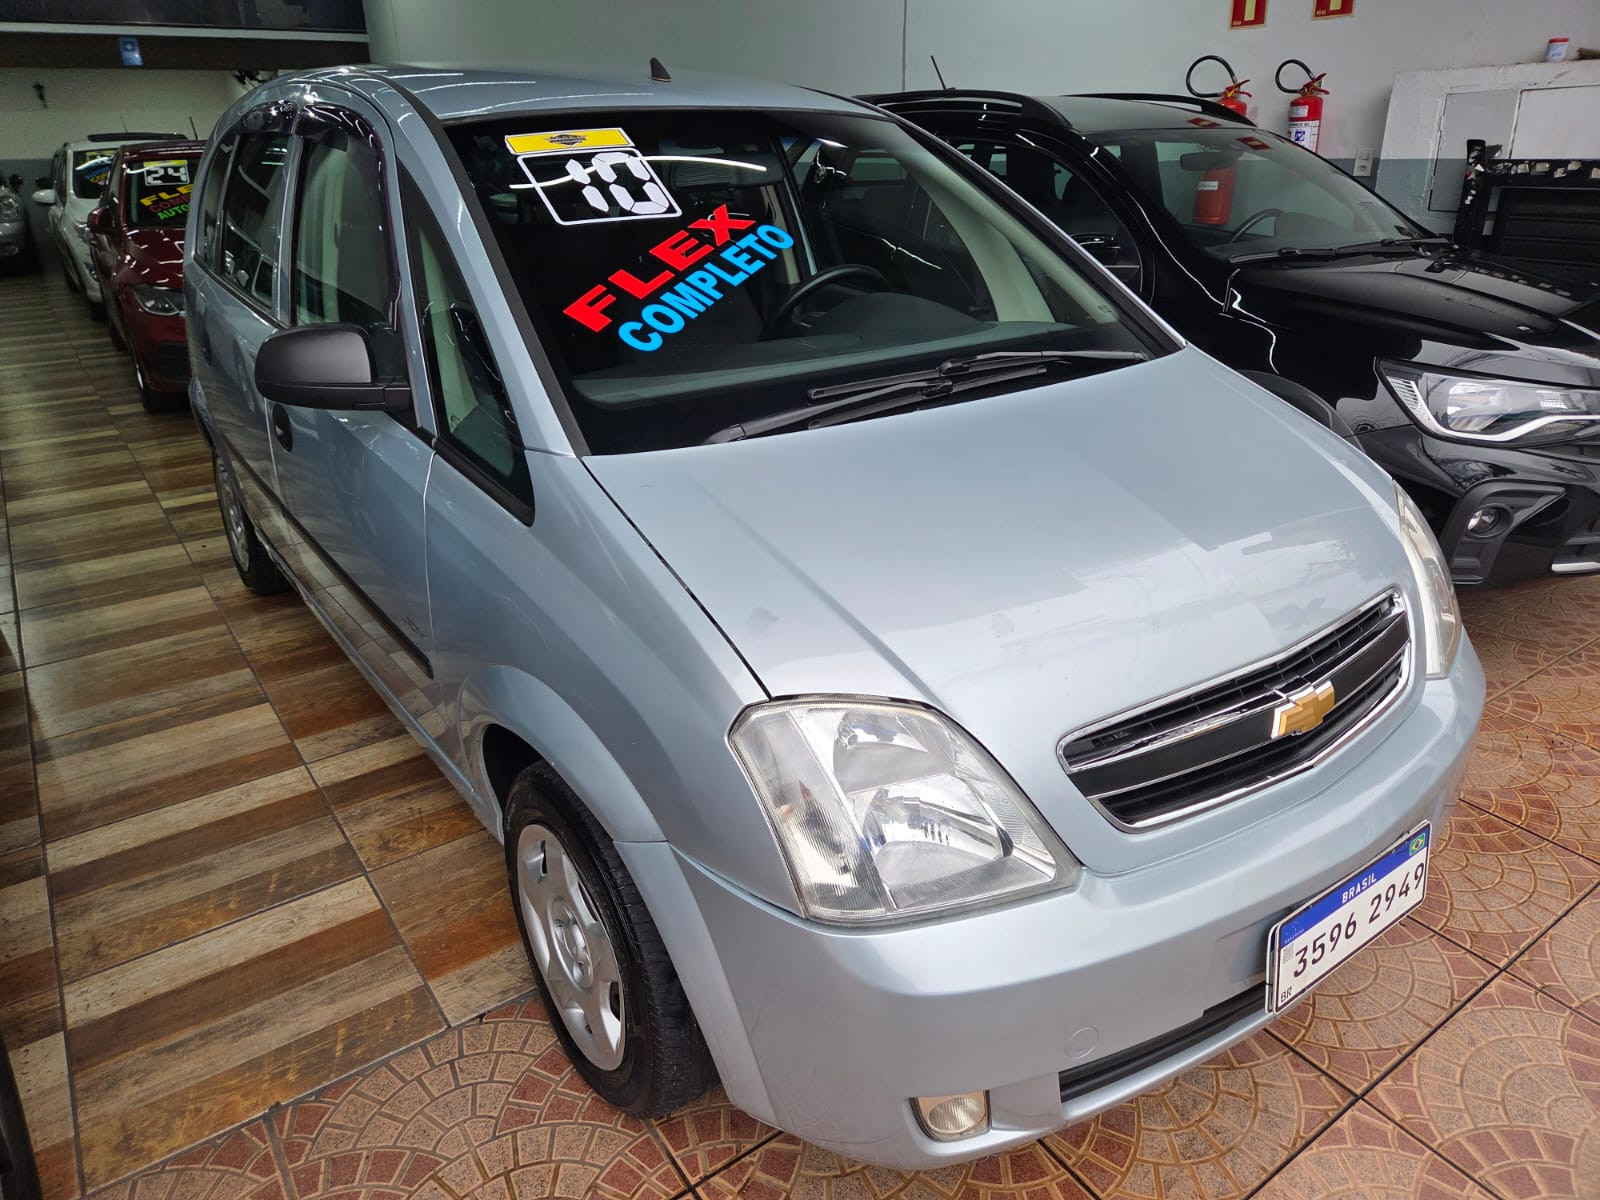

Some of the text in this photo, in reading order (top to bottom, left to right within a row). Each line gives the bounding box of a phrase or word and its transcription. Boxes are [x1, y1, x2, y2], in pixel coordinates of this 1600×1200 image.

[147, 167, 187, 184] 24
[565, 152, 669, 214] 10
[563, 204, 756, 332] FLEX
[618, 225, 794, 351] COMPLETO
[1342, 873, 1377, 904] BRASIL
[1293, 863, 1424, 978] 3596 2949
[1280, 986, 1293, 1002] BR
